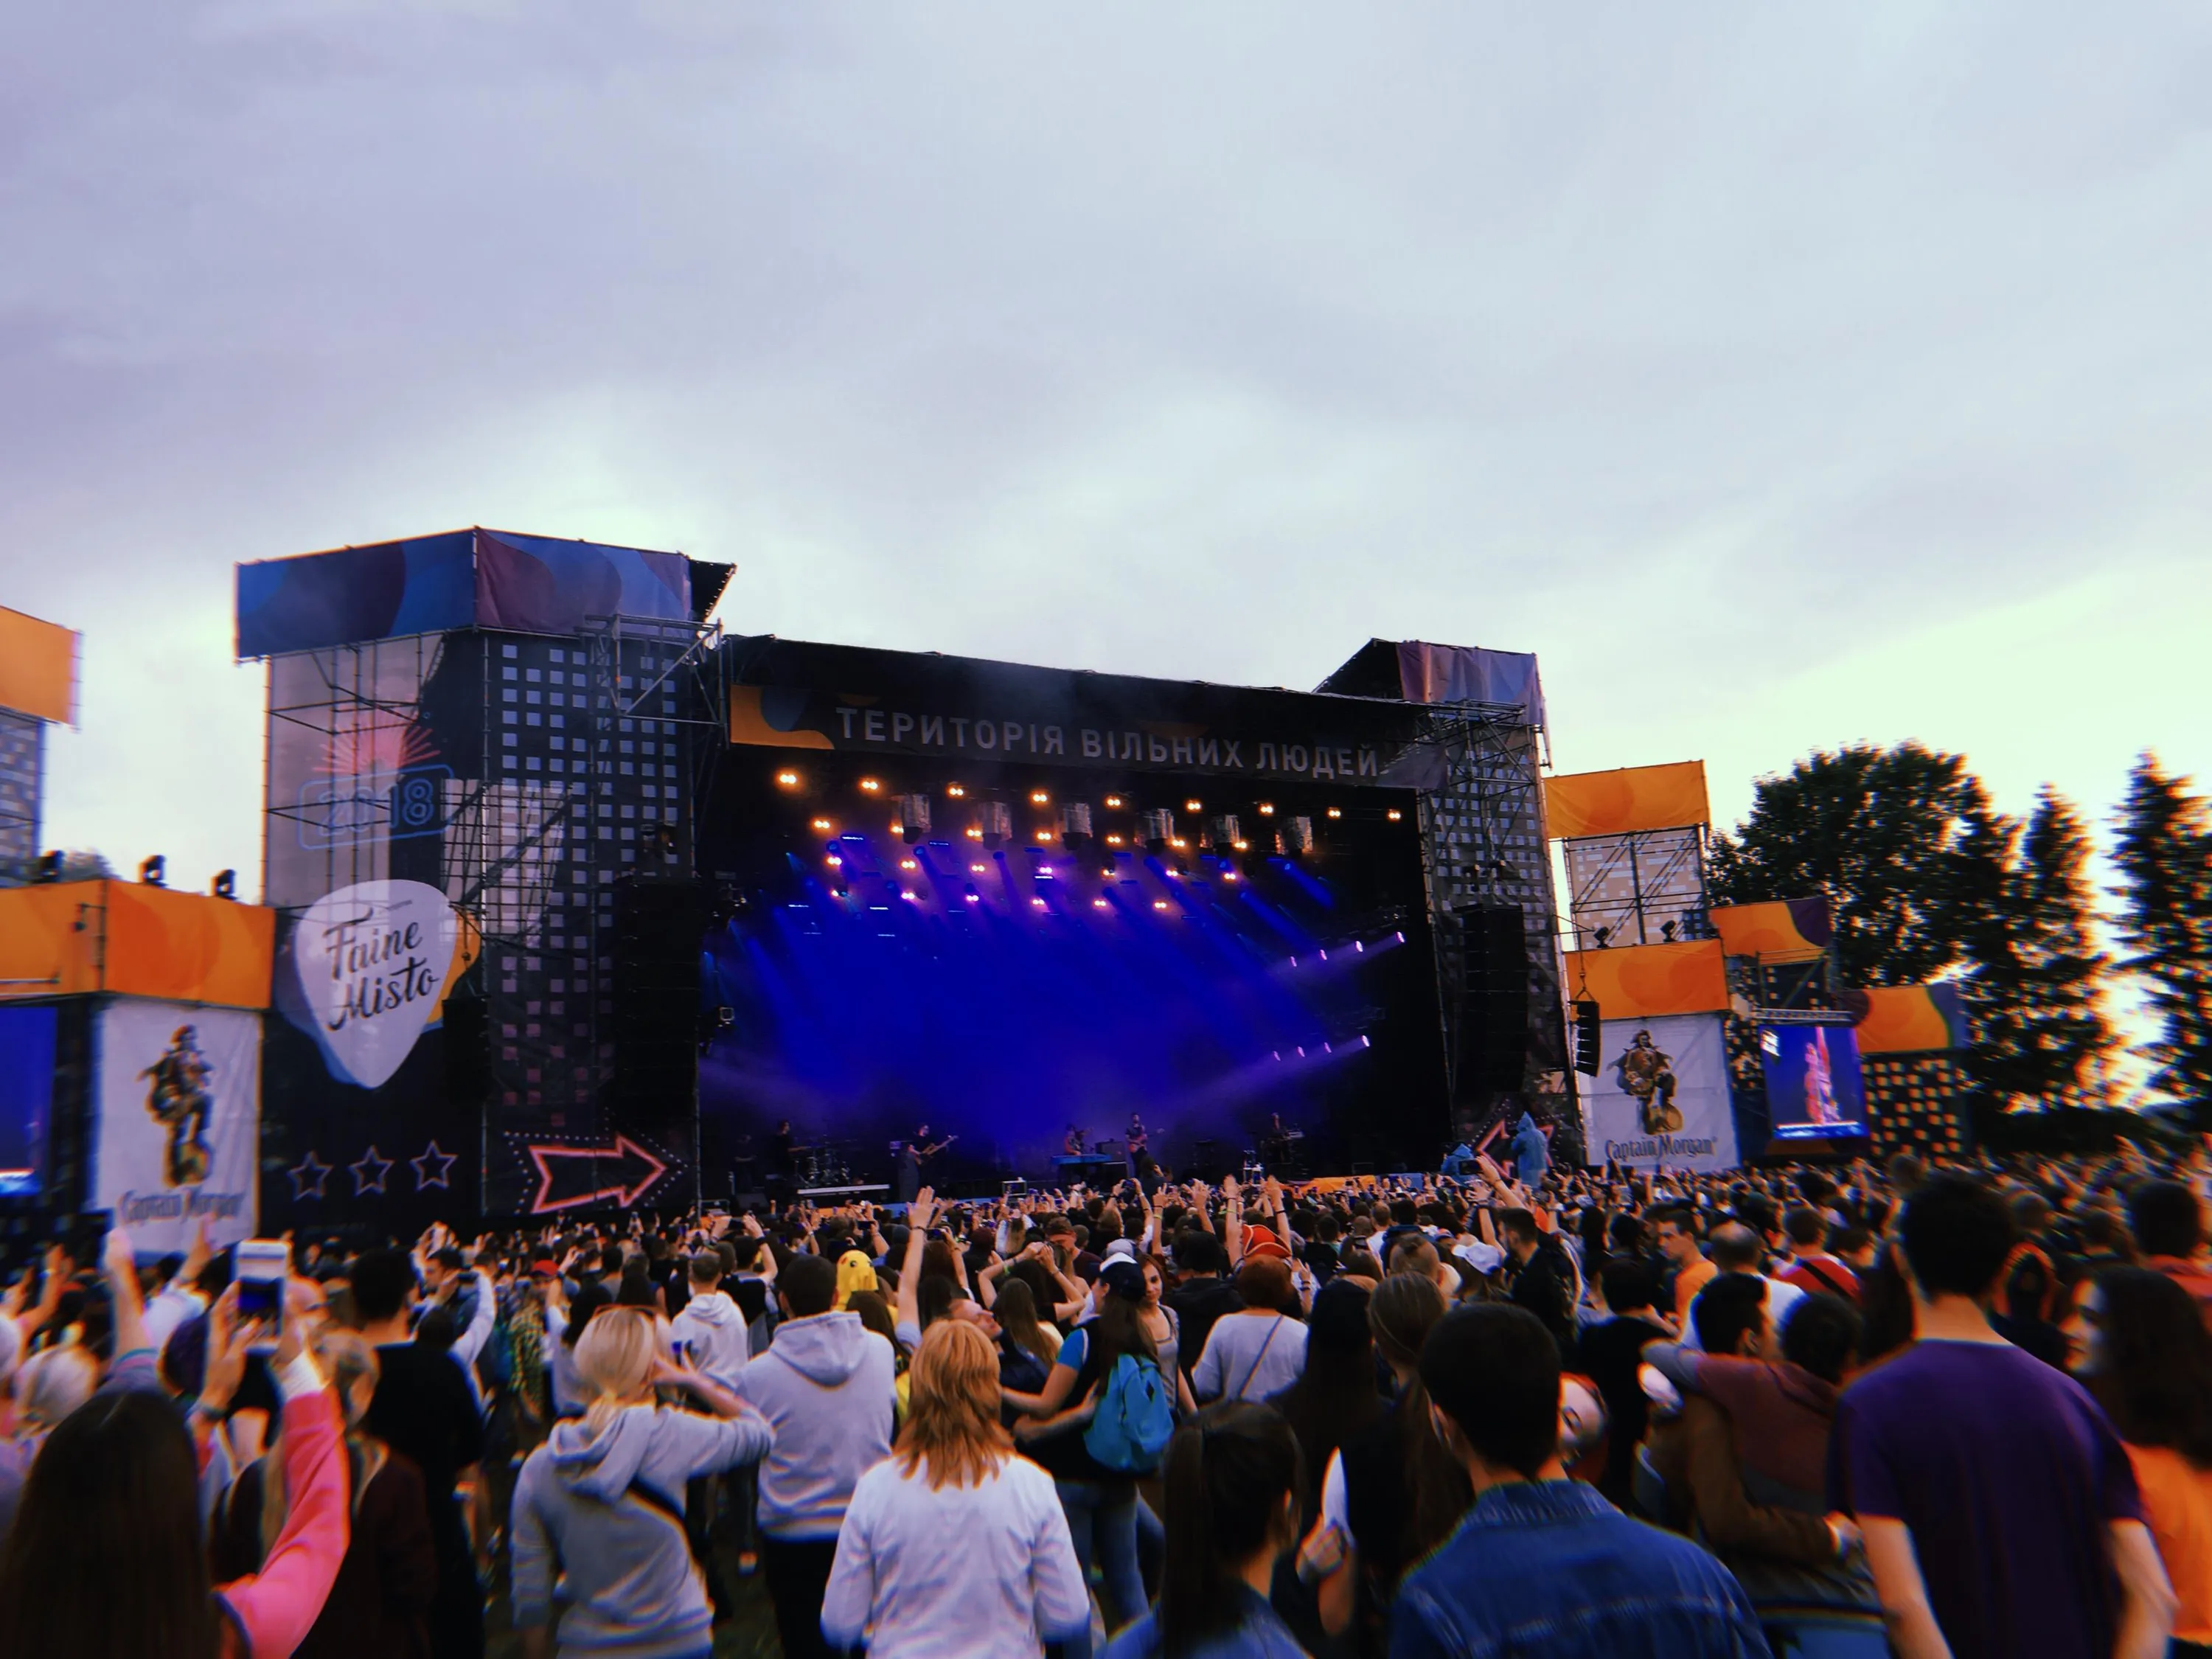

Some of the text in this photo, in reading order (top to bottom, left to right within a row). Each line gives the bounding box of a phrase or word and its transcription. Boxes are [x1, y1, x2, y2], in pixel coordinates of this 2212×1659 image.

[836, 707, 1377, 780] ТЕРИТОРІЯ ВІЛЬНИХ ЛЮДЕЙ
[318, 779, 434, 837] 2018
[322, 907, 422, 980] Faine
[326, 956, 440, 1031] Misto
[1606, 1138, 1658, 1162] Captain
